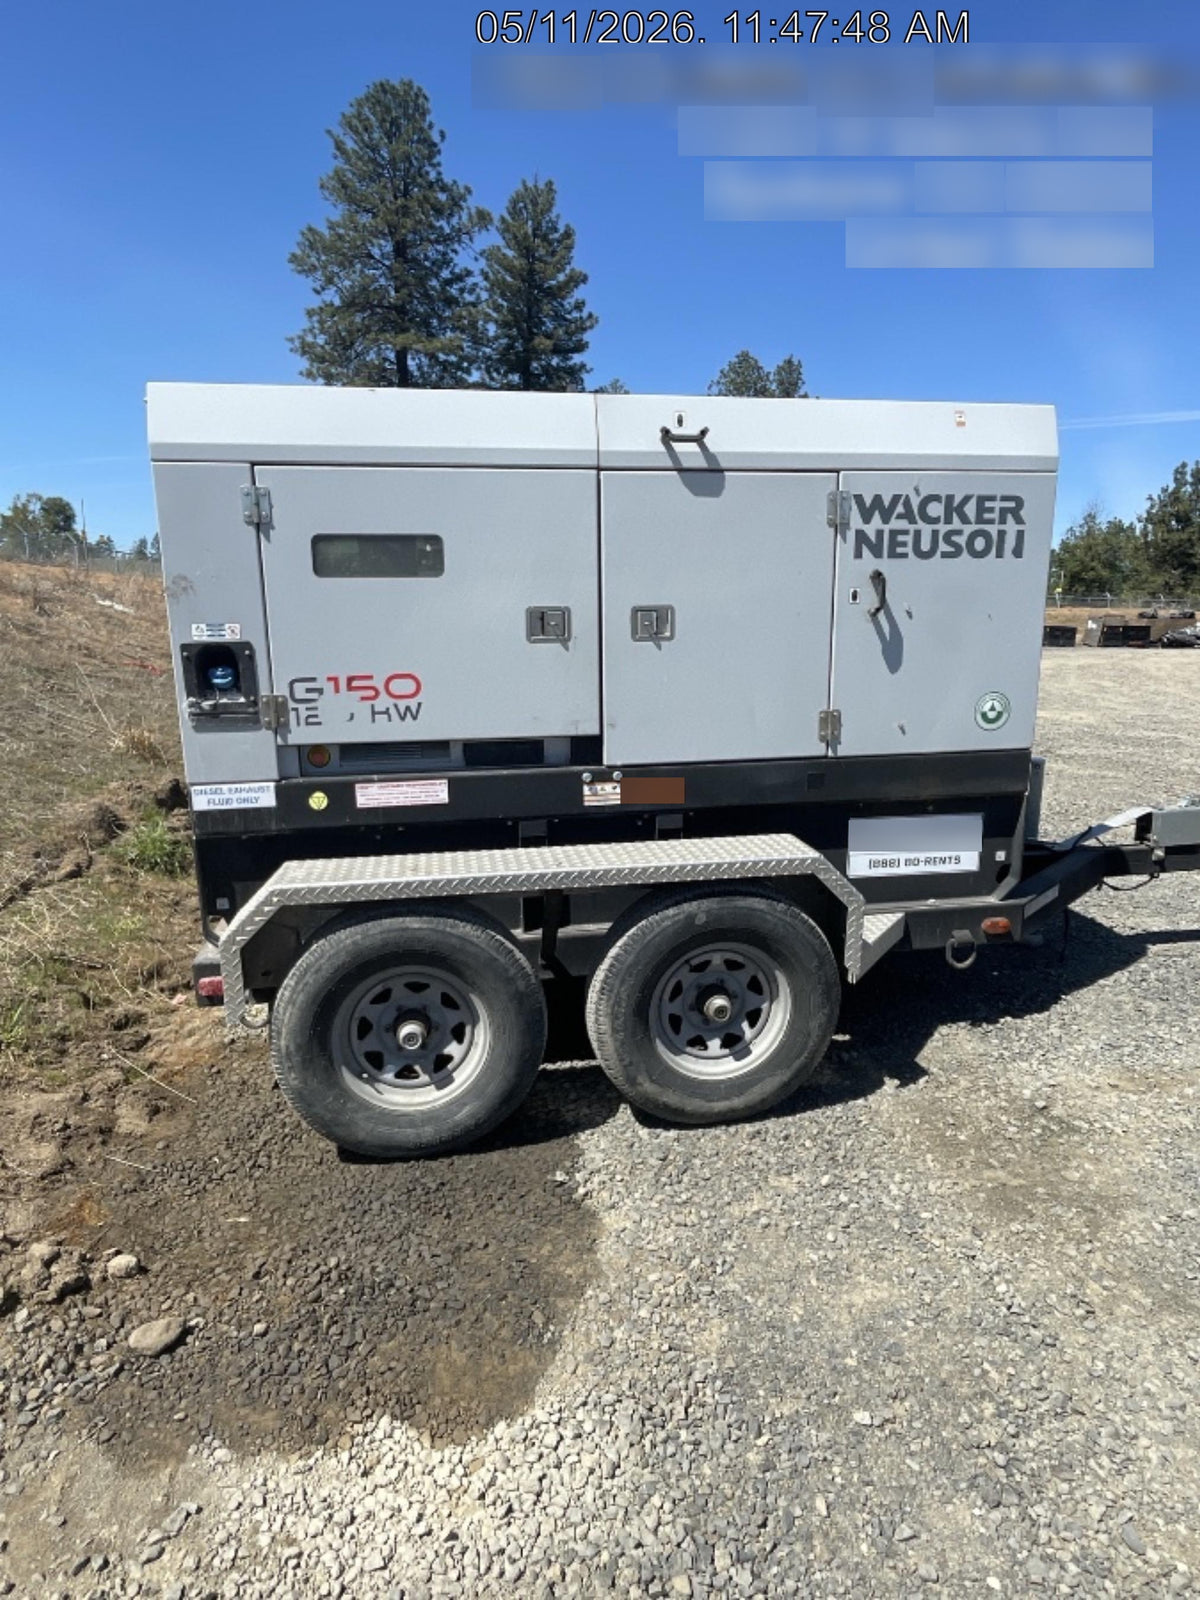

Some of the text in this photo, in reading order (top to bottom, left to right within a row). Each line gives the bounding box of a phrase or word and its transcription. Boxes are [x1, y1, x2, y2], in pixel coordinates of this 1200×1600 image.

[853, 493, 1026, 525] WACKER
[853, 528, 1025, 560] NEUSON
[289, 673, 422, 704] G150
